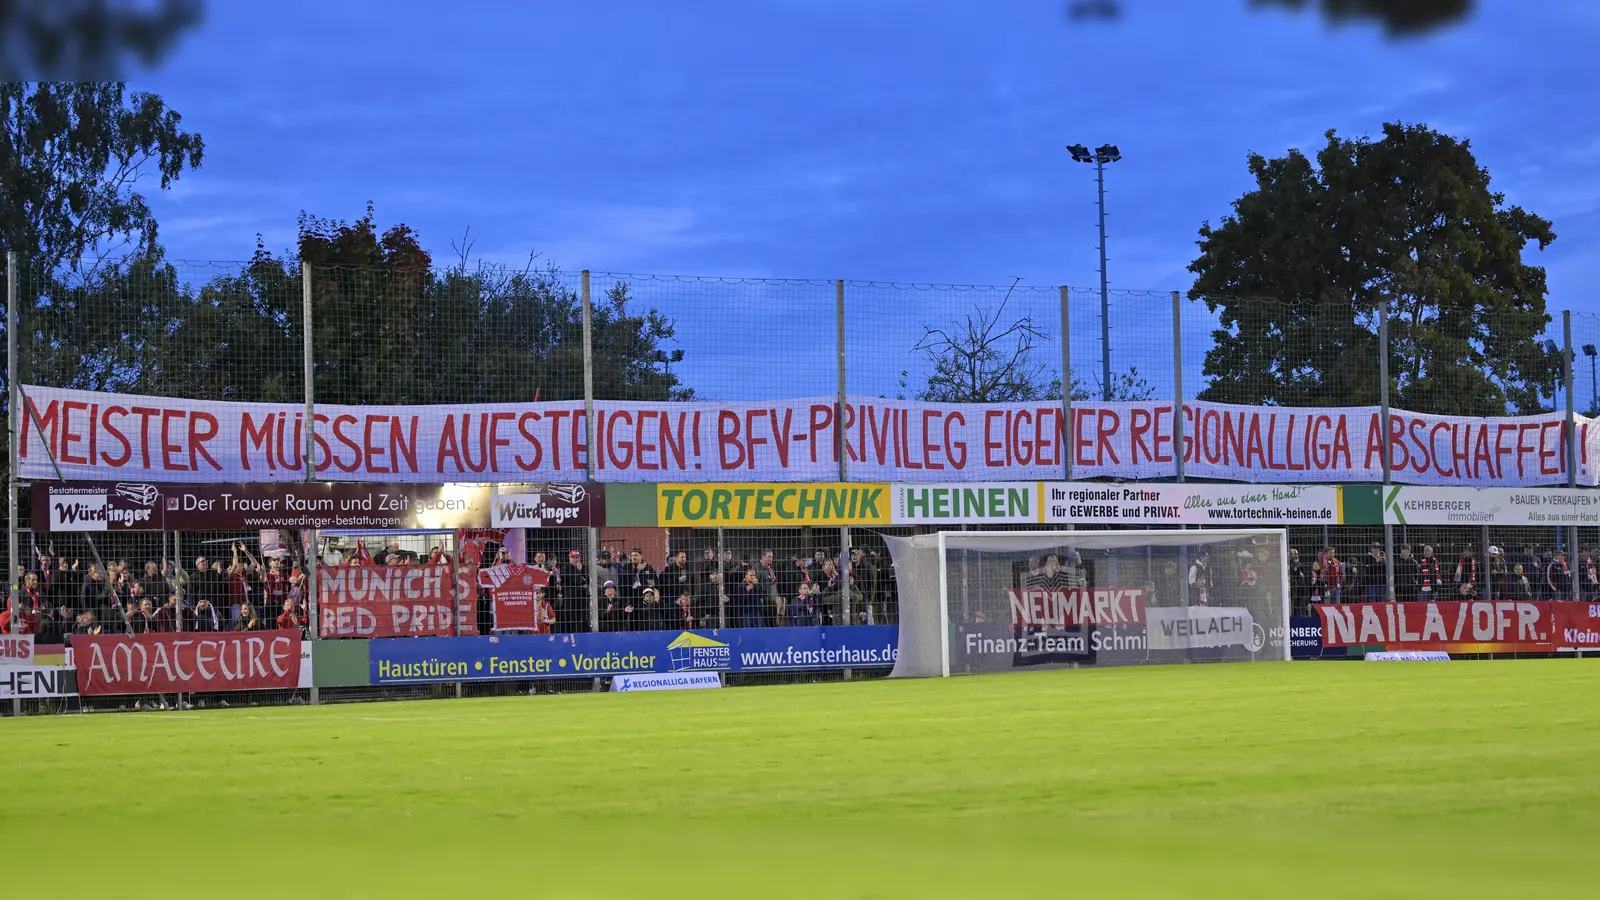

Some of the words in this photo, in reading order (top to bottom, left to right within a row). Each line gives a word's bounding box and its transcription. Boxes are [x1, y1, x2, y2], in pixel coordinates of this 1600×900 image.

[19, 396, 223, 471] MEISTER
[240, 411, 418, 473] MÜSSEN
[437, 409, 702, 473] AUFSTEIGEN!
[718, 402, 967, 470] BFV-PRIVILEG
[984, 407, 1120, 467] EIGENER
[1131, 404, 1352, 471] REGIONALLIGA
[48, 486, 109, 495] Bestattermeister
[1051, 488, 1066, 501] Ihr
[1069, 488, 1120, 503] regionaler
[1123, 489, 1161, 502] Partner
[1183, 494, 1213, 510] Alles
[1217, 497, 1237, 506] aus
[1241, 492, 1268, 504] einer
[1272, 486, 1302, 501] Hand!
[1515, 494, 1540, 505] BAUEN
[1547, 494, 1591, 506] VERKAUFEN
[183, 493, 216, 511] Der
[220, 493, 279, 511] Trauer
[285, 493, 334, 511] Raum
[340, 493, 374, 511] und
[378, 492, 410, 511] Zeit
[661, 488, 884, 520] TORTECHNIK
[907, 488, 1029, 518] HEINEN
[1051, 505, 1067, 518] für
[1069, 506, 1119, 518] GEWERBE
[1122, 506, 1141, 518] und
[1143, 506, 1181, 519] PRIVAT.
[1403, 500, 1471, 511] KEHRBERGER
[54, 501, 152, 527] Würdinger
[495, 501, 580, 524] Würdinger
[1208, 506, 1332, 520] www.tortechnik-heinen.de
[1447, 511, 1495, 522] Immobilien
[1528, 511, 1546, 522] Alles
[1547, 513, 1561, 522] aus
[1561, 511, 1579, 522] einer
[1580, 512, 1599, 522] Hand
[1008, 589, 1143, 625] NEUMARKT
[322, 606, 377, 635] RED
[1161, 616, 1243, 637] WEILACH
[1321, 602, 1547, 644] NAILA/OFR.
[693, 647, 730, 657] FENSTER
[966, 632, 1085, 654] Finanz-Team
[85, 636, 291, 691] AMATEURE
[379, 658, 468, 678] Haustüren
[490, 656, 552, 674] Fenster
[571, 651, 656, 671] Vordächer
[693, 658, 718, 668] HAUS
[741, 643, 899, 665] www.fensterhaus.de
[633, 677, 688, 689] REGIONALLIGA
[690, 676, 719, 685] BAYERN
